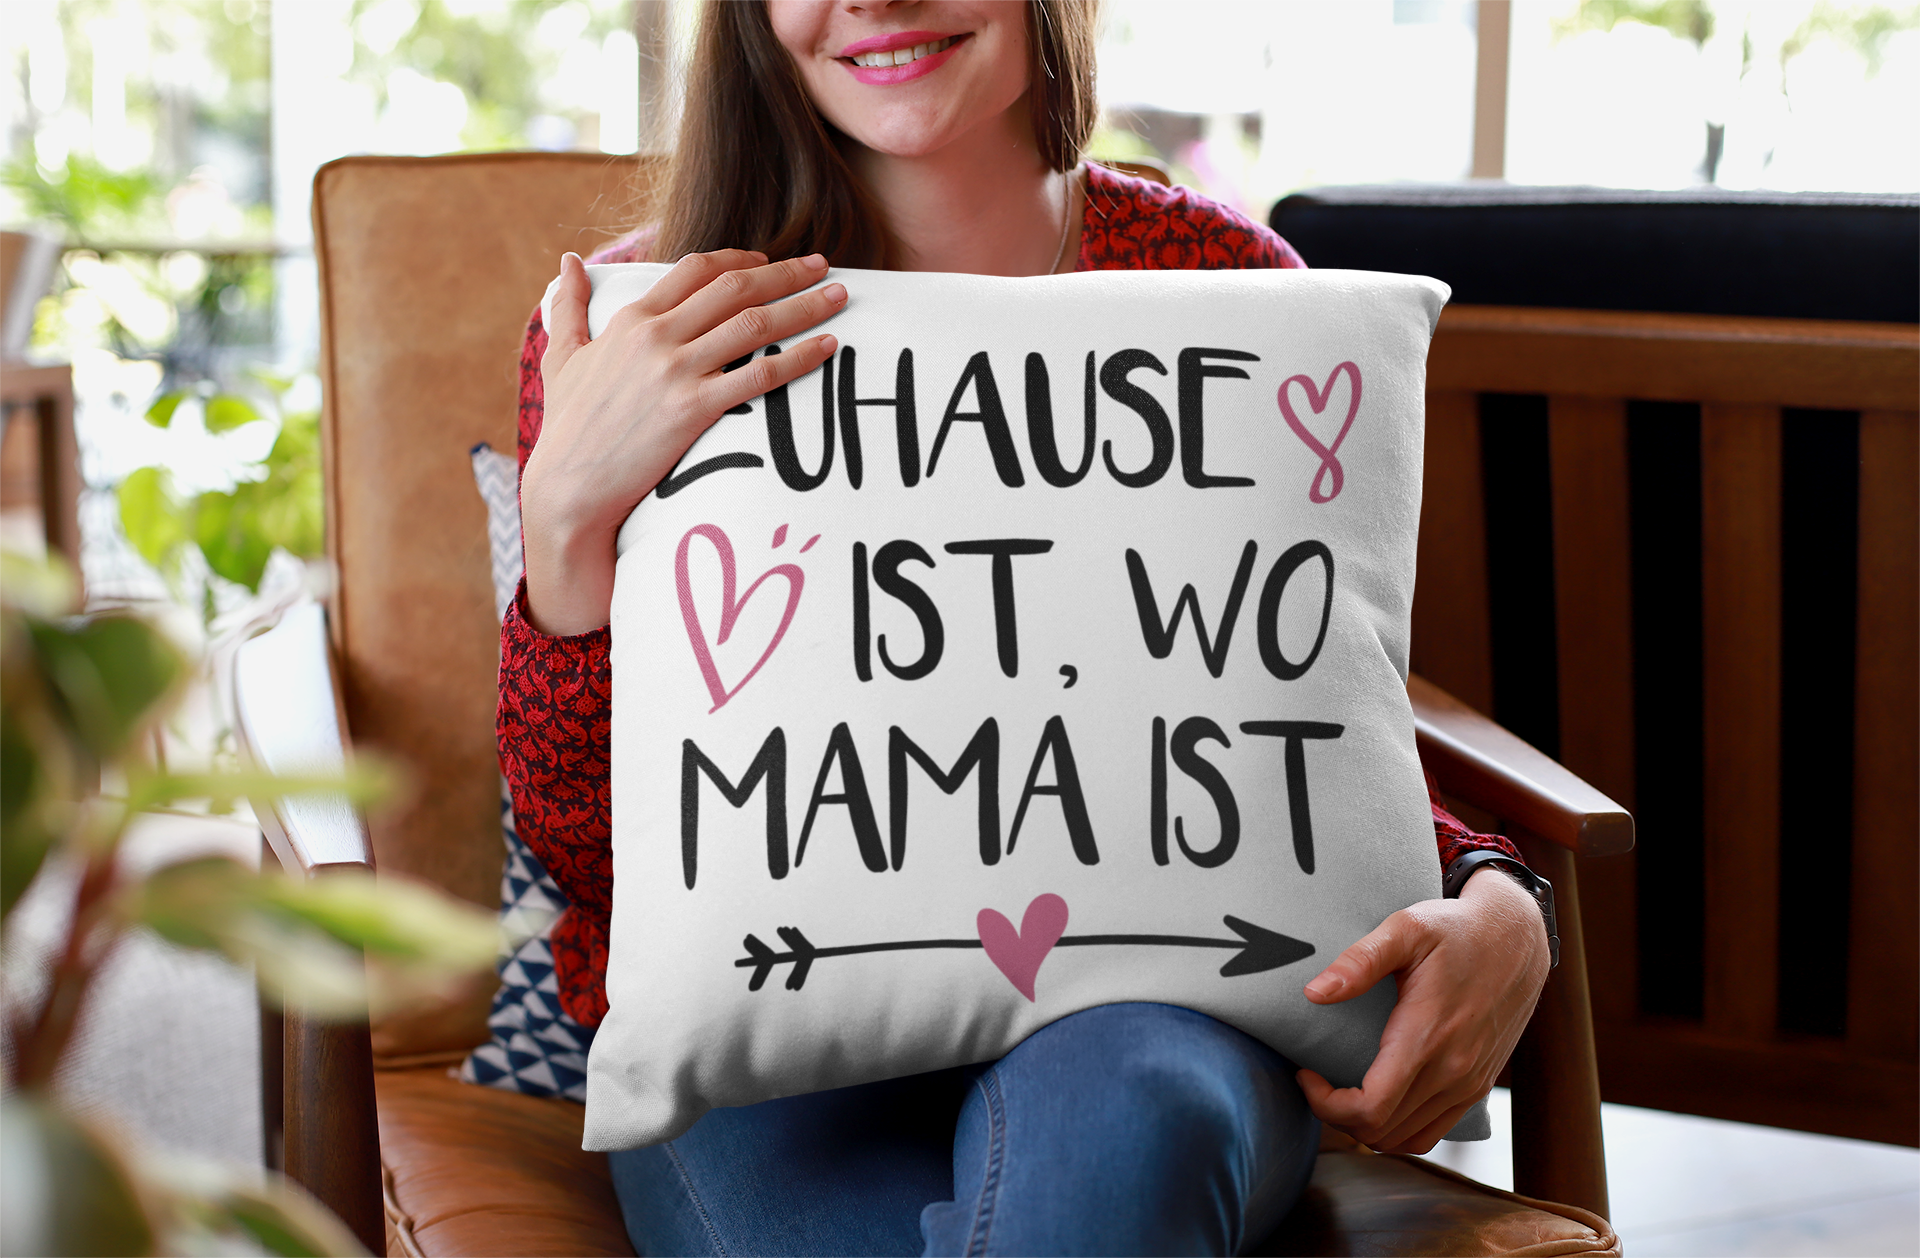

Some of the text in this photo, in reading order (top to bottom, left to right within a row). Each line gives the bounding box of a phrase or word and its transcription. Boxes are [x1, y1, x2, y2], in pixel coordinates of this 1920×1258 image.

[852, 537, 1335, 689] IST, WO
[681, 715, 1346, 890] MAMA IST
